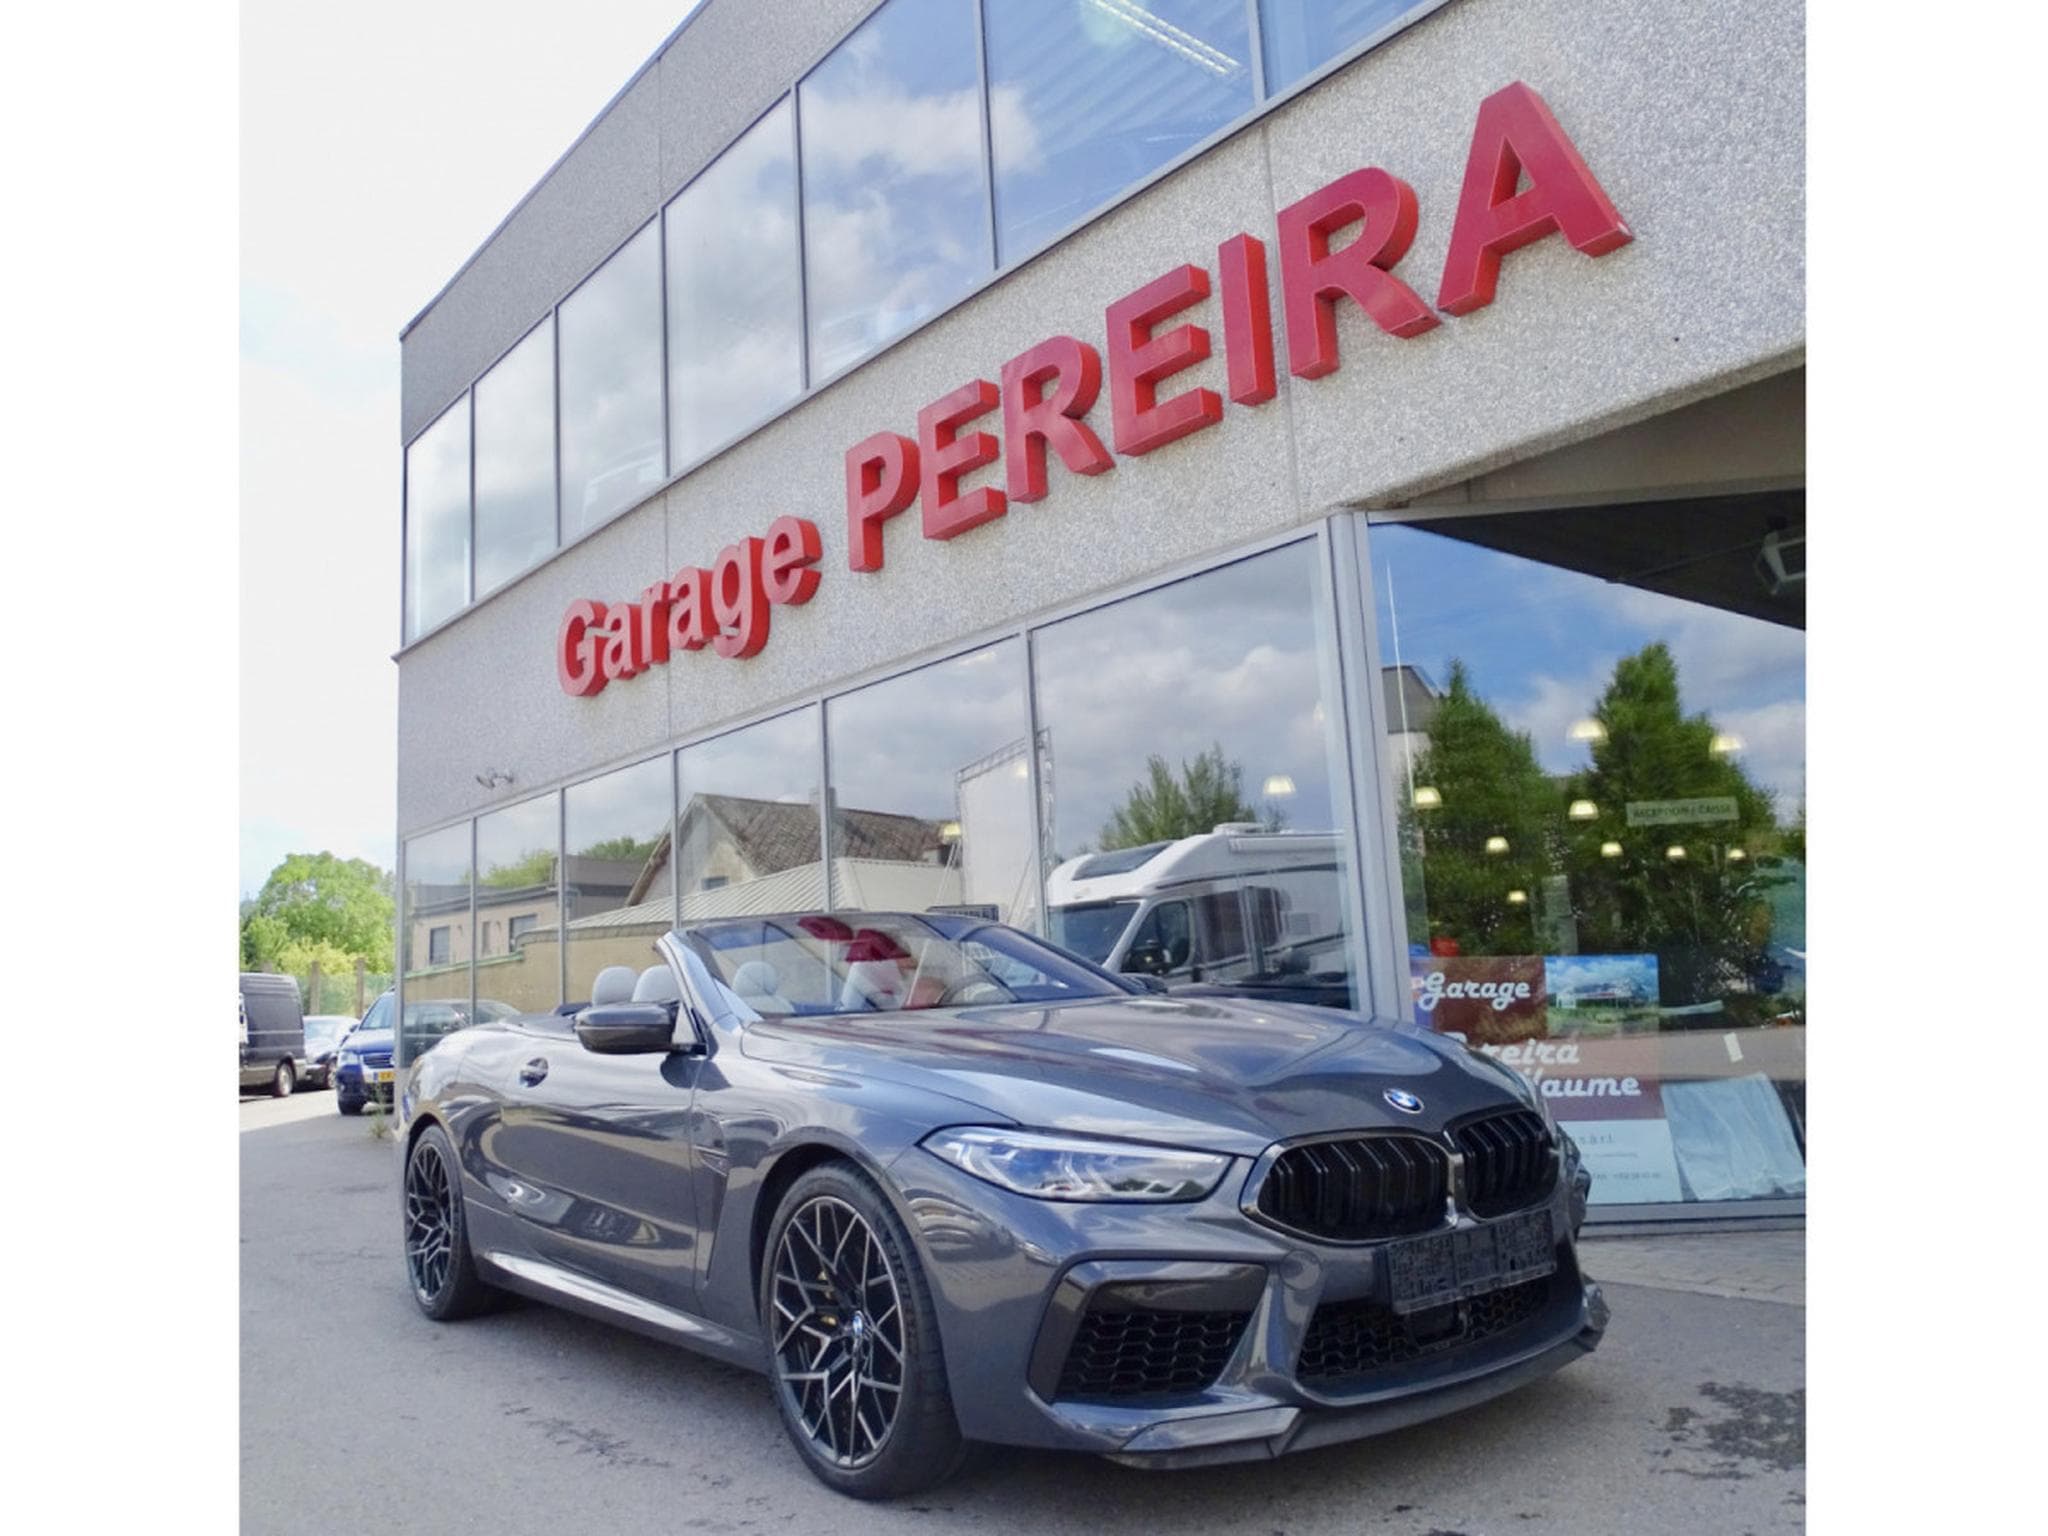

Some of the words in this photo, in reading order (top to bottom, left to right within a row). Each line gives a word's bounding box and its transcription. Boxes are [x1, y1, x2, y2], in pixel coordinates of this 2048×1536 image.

[557, 515, 823, 697] Garage
[845, 80, 1634, 573] PEREIRA
[1418, 972, 1531, 1011] Garage
[1442, 1031, 1580, 1065] reira
